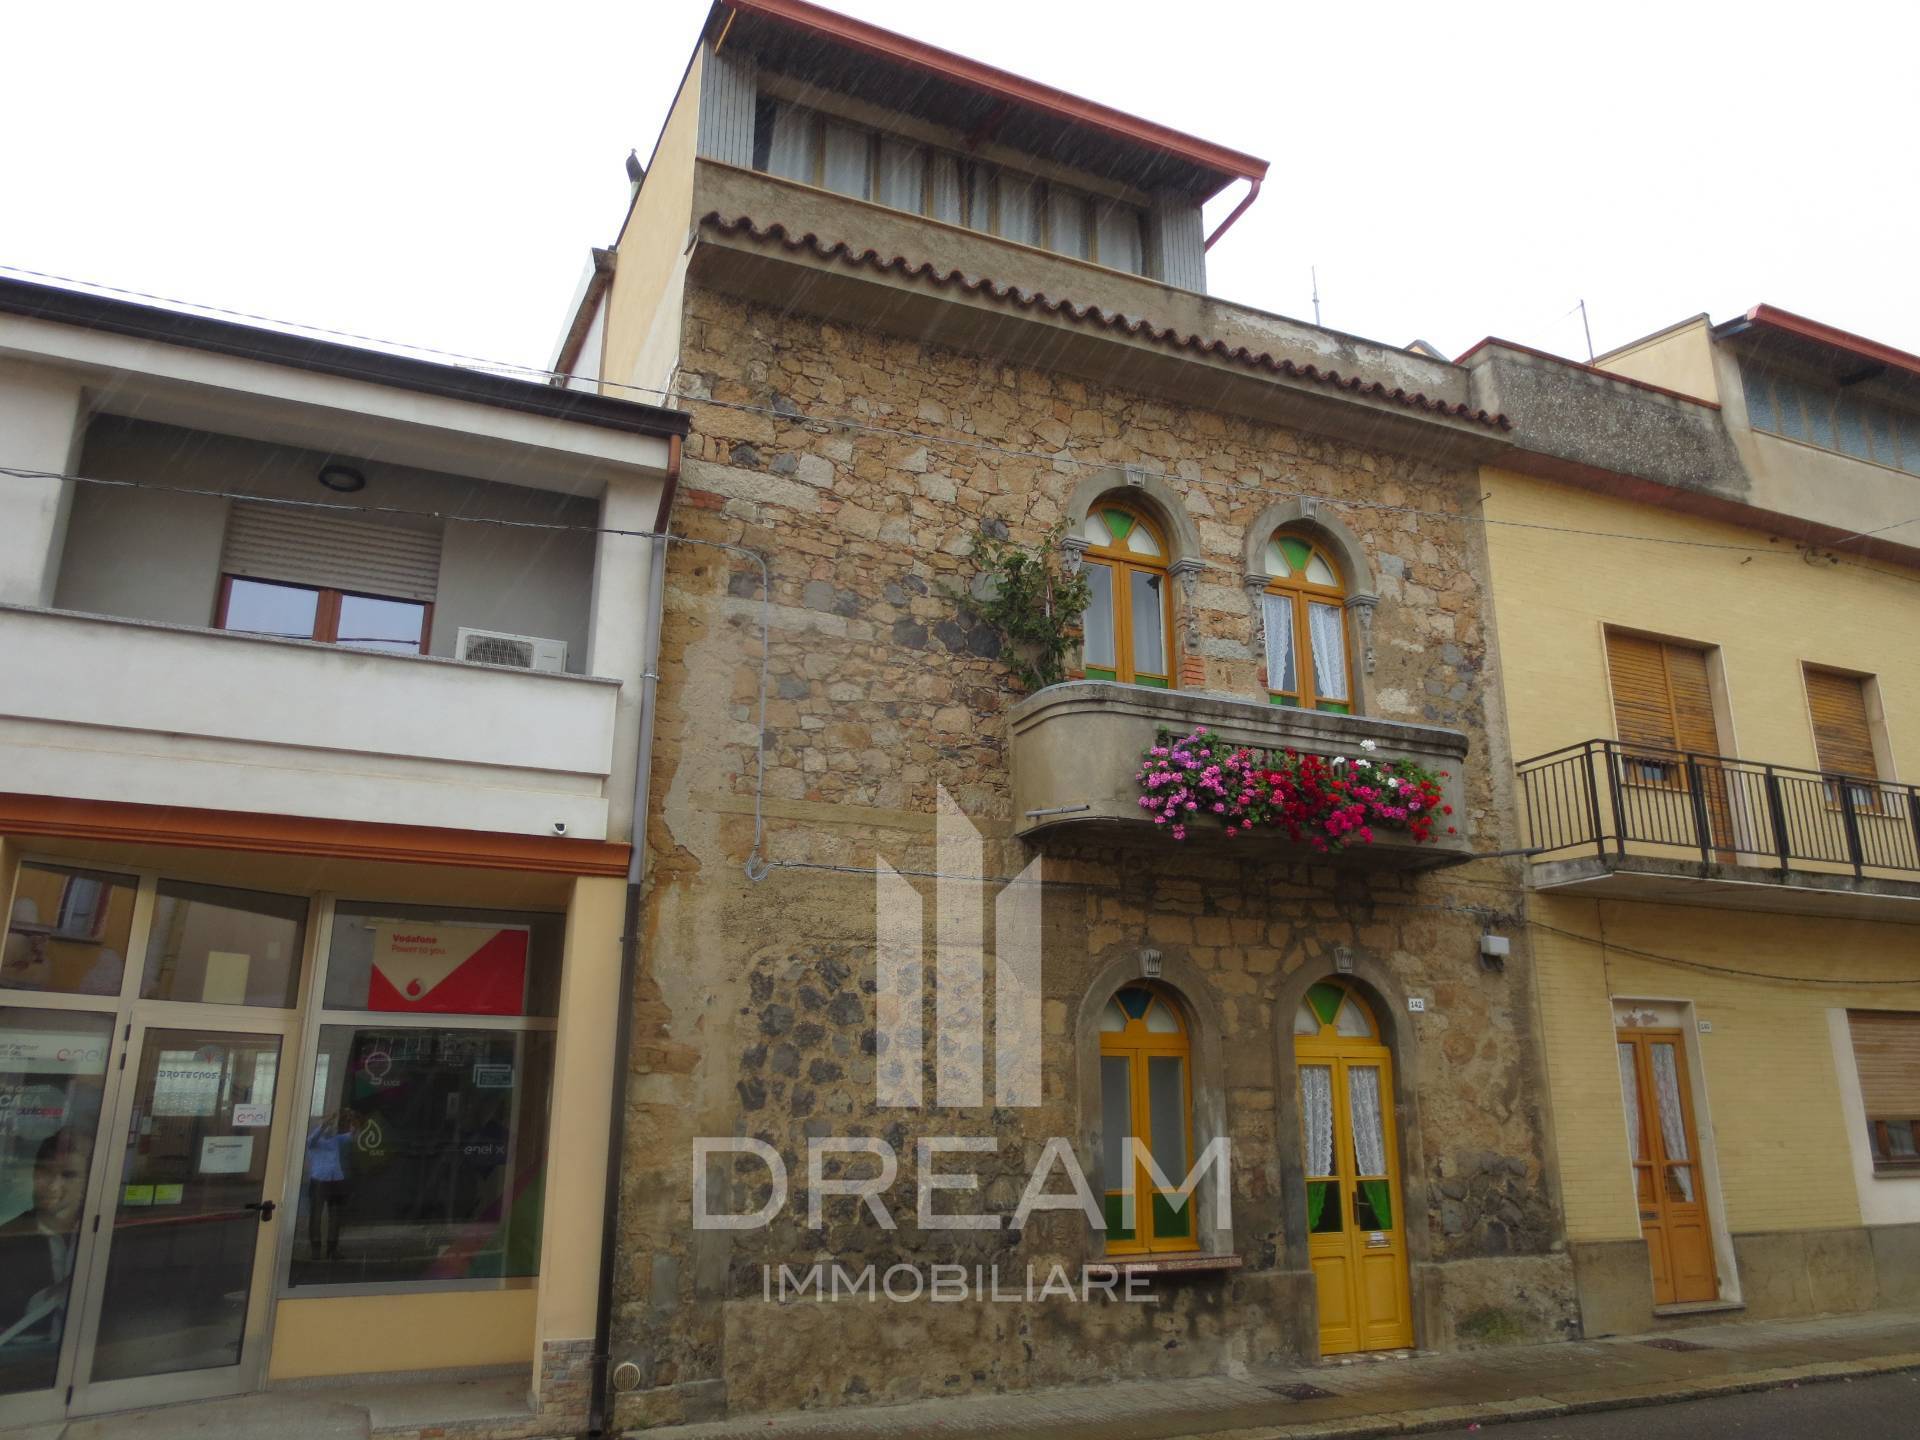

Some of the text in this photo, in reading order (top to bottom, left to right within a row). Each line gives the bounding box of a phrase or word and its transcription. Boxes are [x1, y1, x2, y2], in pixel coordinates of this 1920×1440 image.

[392, 933, 438, 944] Vodafone
[391, 944, 417, 954] Power
[419, 945, 428, 954] to
[1410, 1001, 1422, 1009] 142
[237, 1111, 267, 1123] enel
[464, 1143, 492, 1155] enel
